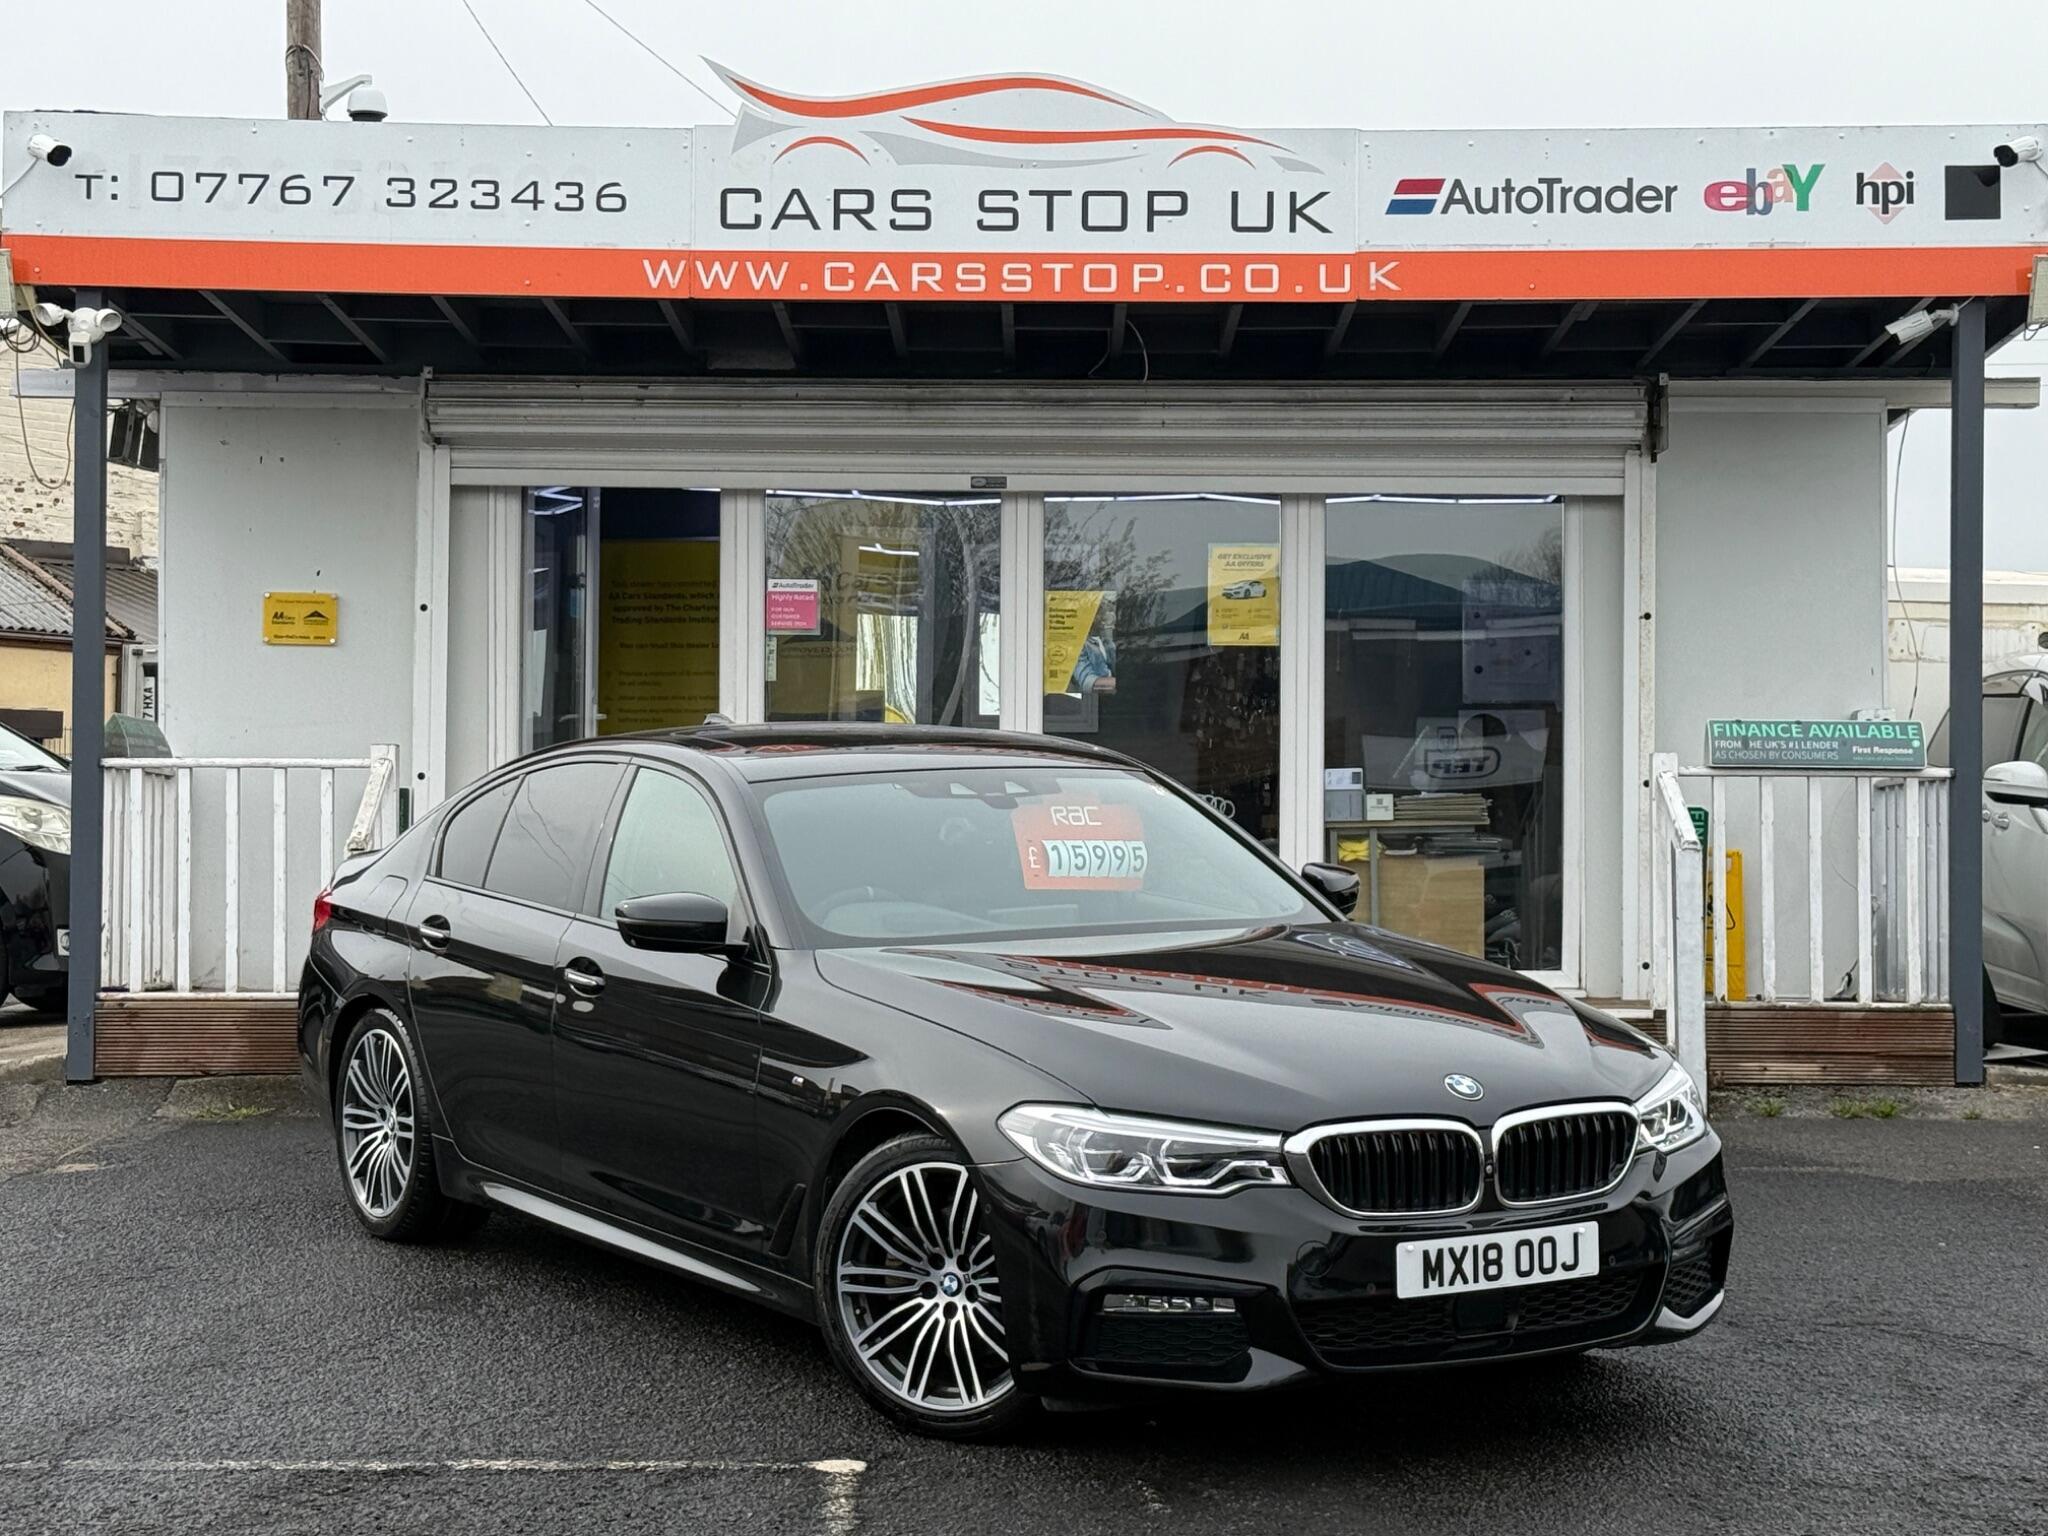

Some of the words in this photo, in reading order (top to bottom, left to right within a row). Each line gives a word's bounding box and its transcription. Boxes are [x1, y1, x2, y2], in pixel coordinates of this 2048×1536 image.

[76, 173, 119, 201] T:
[151, 171, 355, 208] 07767
[386, 177, 628, 213] 323436
[1441, 176, 1678, 216] AutoTrader
[1856, 171, 1915, 216] hpi
[720, 187, 933, 232] CARS
[977, 189, 1189, 234] STOP
[1231, 190, 1334, 235] UK
[642, 257, 1402, 294] WWW.CARSSTOP.CO.UK
[1713, 723, 1804, 738] FINANCE
[1808, 724, 1921, 739] AVAILABLE
[1714, 740, 1742, 749] FROM
[1801, 741, 1839, 750] LENDER
[1714, 751, 1728, 759] AS
[1729, 751, 1767, 760] CHOSEN
[1768, 751, 1780, 759] BY
[1781, 751, 1839, 760] CONSUMERS
[1852, 745, 1871, 754] First
[1872, 745, 1914, 756] Response
[1028, 846, 1041, 869] £
[1051, 844, 1146, 873] 15995
[1422, 1242, 1504, 1289] MX18
